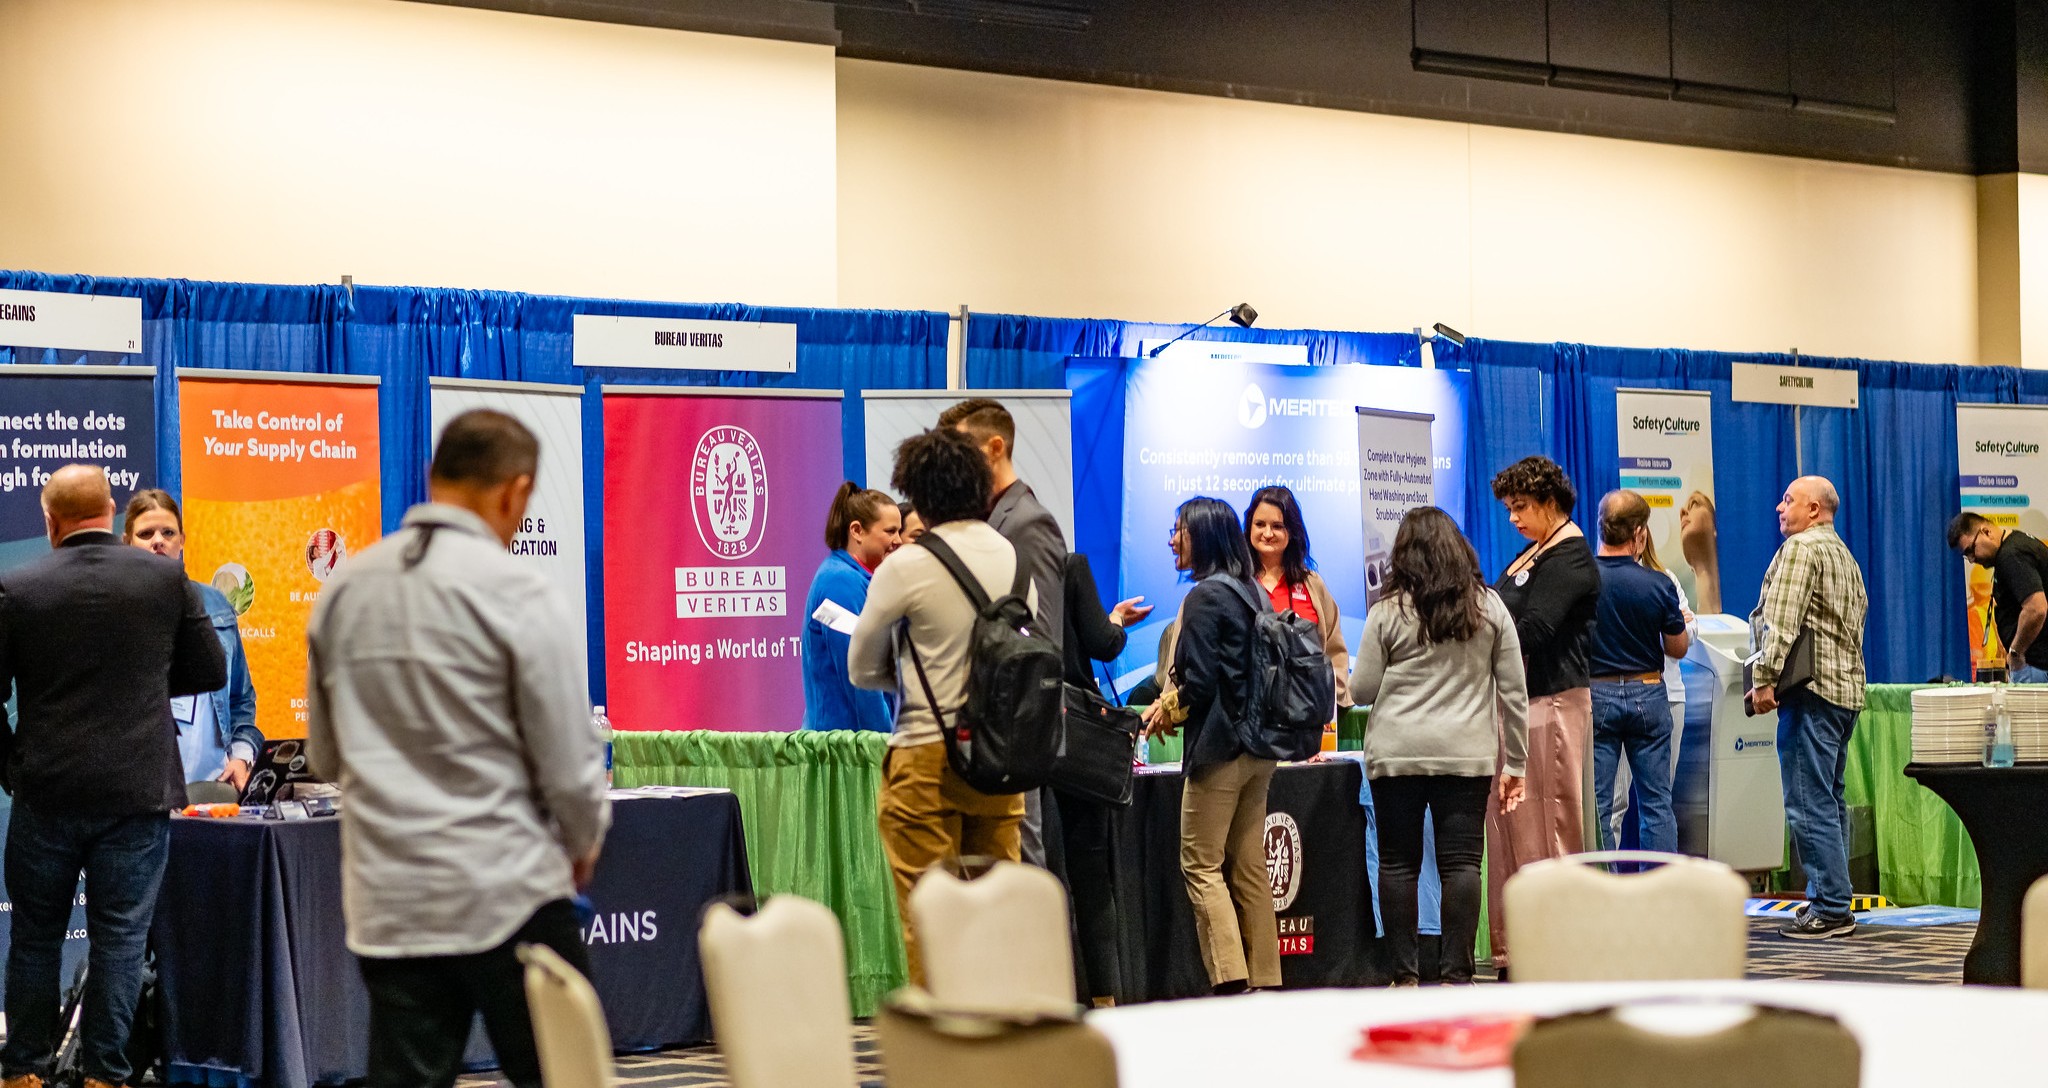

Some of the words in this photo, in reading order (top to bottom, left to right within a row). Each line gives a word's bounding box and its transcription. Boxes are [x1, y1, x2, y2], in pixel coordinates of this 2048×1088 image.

[128, 340, 135, 348] 21
[654, 331, 688, 347] BUREAU
[689, 333, 723, 348] VERITAS
[1779, 375, 1814, 389] SAFETYCULTURE
[46, 410, 79, 430] the
[83, 410, 126, 430] dots
[212, 409, 253, 429] Take
[257, 411, 322, 431] Control
[325, 413, 344, 432] of
[1633, 416, 1700, 434] SafetyCulture
[12, 438, 127, 459] formulation
[203, 437, 244, 456] Your
[247, 438, 306, 462] Supply
[309, 439, 357, 459] Chain
[1975, 440, 2039, 456] SafetyCulture
[695, 430, 726, 497] BUREAU
[730, 430, 765, 497] VERITAS
[1140, 447, 1219, 469] Consistently
[1223, 451, 1270, 465] remove
[1272, 453, 1304, 465] more
[1307, 449, 1334, 466] than
[1367, 449, 1393, 465] Complete
[1393, 451, 1405, 463] Your
[1406, 453, 1427, 468] Hygiene
[1636, 458, 1651, 467] Raise
[1652, 460, 1669, 468] issues
[0, 466, 27, 492] gh
[1164, 474, 1176, 491] in
[1177, 475, 1203, 496] just
[1205, 475, 1220, 491] 12
[1296, 475, 1345, 492] ultimate
[1364, 468, 1378, 481] Zone
[1378, 470, 1390, 482] with
[1390, 470, 1432, 486] Fully-Automated
[1638, 477, 1659, 486] Perform
[1660, 477, 1680, 487] checks
[1978, 476, 1994, 486] Raise
[1995, 477, 2015, 486] issues
[1369, 488, 1383, 501] Hand
[1383, 489, 1406, 505] Washing
[1406, 491, 1416, 502] and
[1653, 497, 1671, 505] teams
[1980, 495, 2003, 504] Perform
[2005, 495, 2027, 505] checks
[1376, 508, 1401, 524] Scrubbing
[1997, 516, 2016, 524] teams
[537, 518, 546, 534] &
[717, 540, 748, 555] 1828
[686, 571, 777, 587] BUREAU
[289, 592, 302, 602] BE
[688, 597, 778, 613] VERITAS
[625, 640, 701, 666] Shaping
[705, 643, 714, 659] a
[717, 637, 767, 659] World
[771, 637, 785, 657] of
[790, 636, 802, 656] T
[295, 712, 309, 722] PE
[580, 910, 658, 946] AINS
